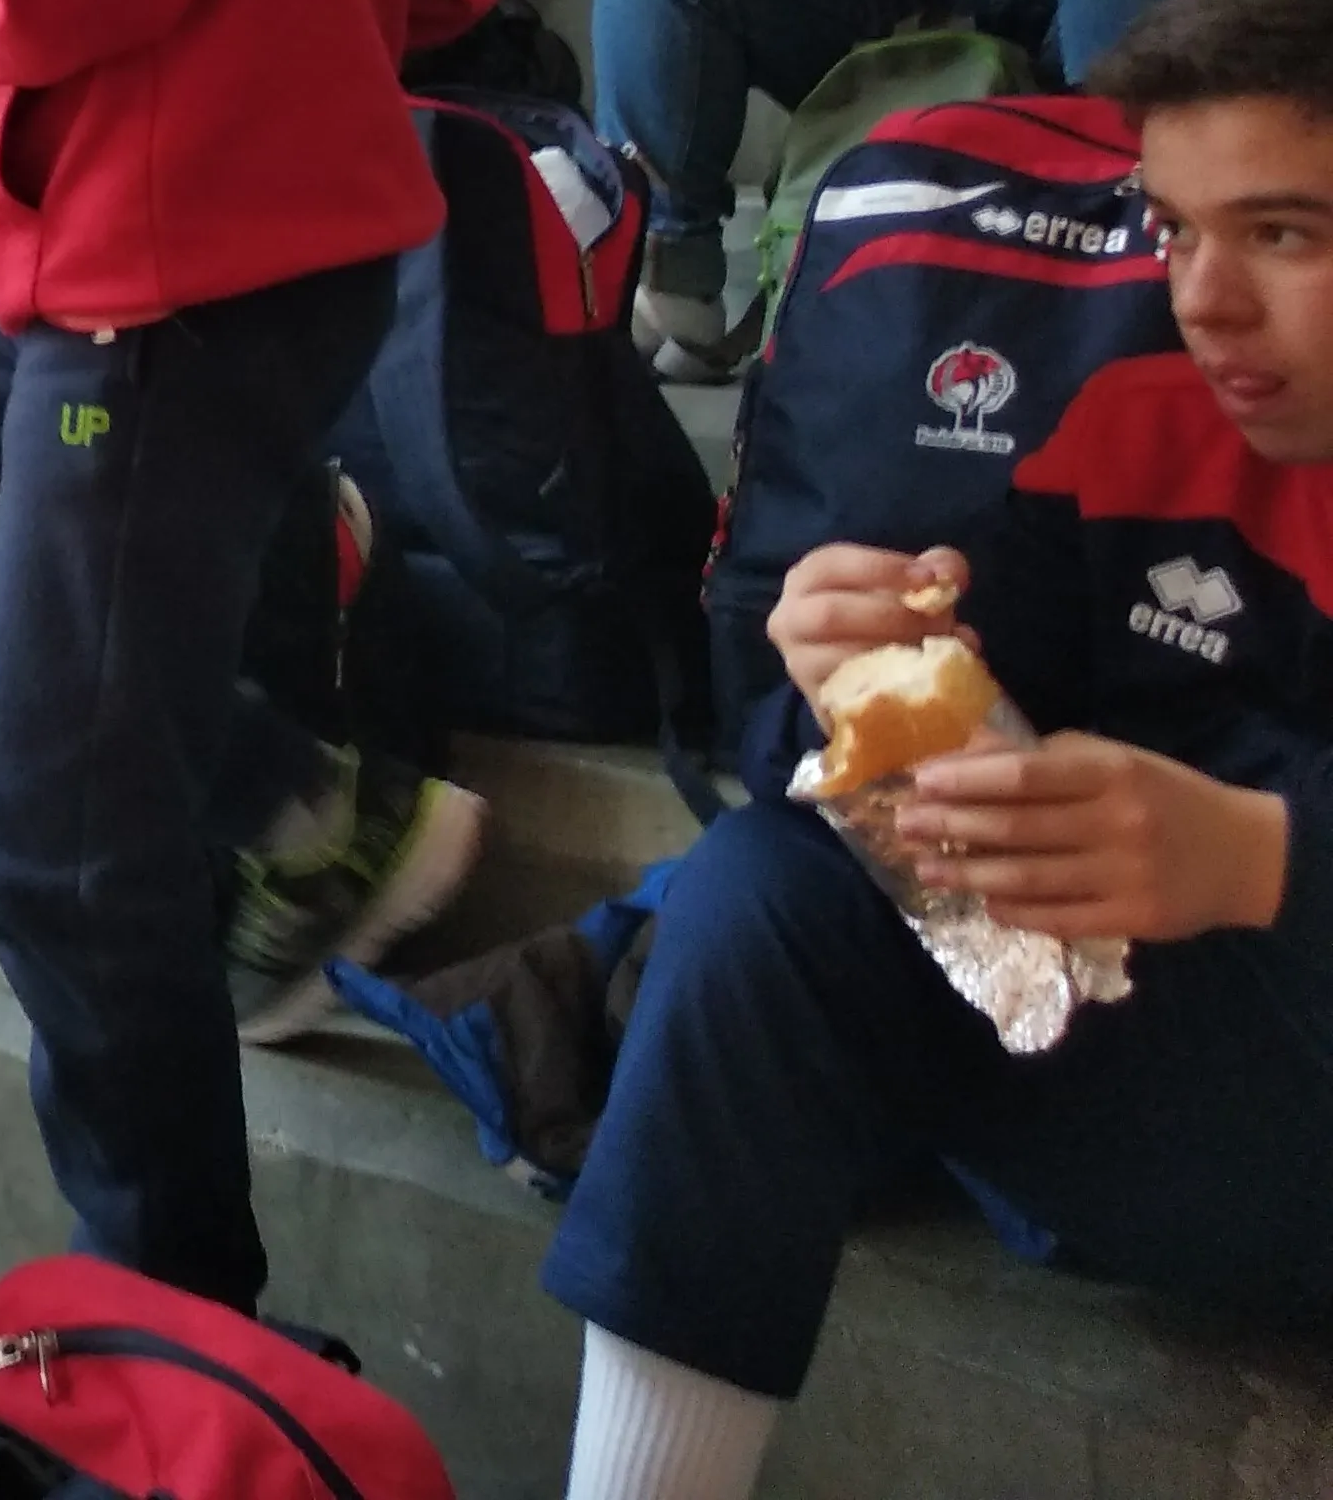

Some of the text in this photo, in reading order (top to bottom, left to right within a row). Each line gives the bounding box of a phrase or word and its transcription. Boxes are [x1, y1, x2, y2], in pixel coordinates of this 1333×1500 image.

[1024, 211, 1130, 254] errea
[59, 402, 111, 448] UP
[1129, 602, 1230, 665] errea
